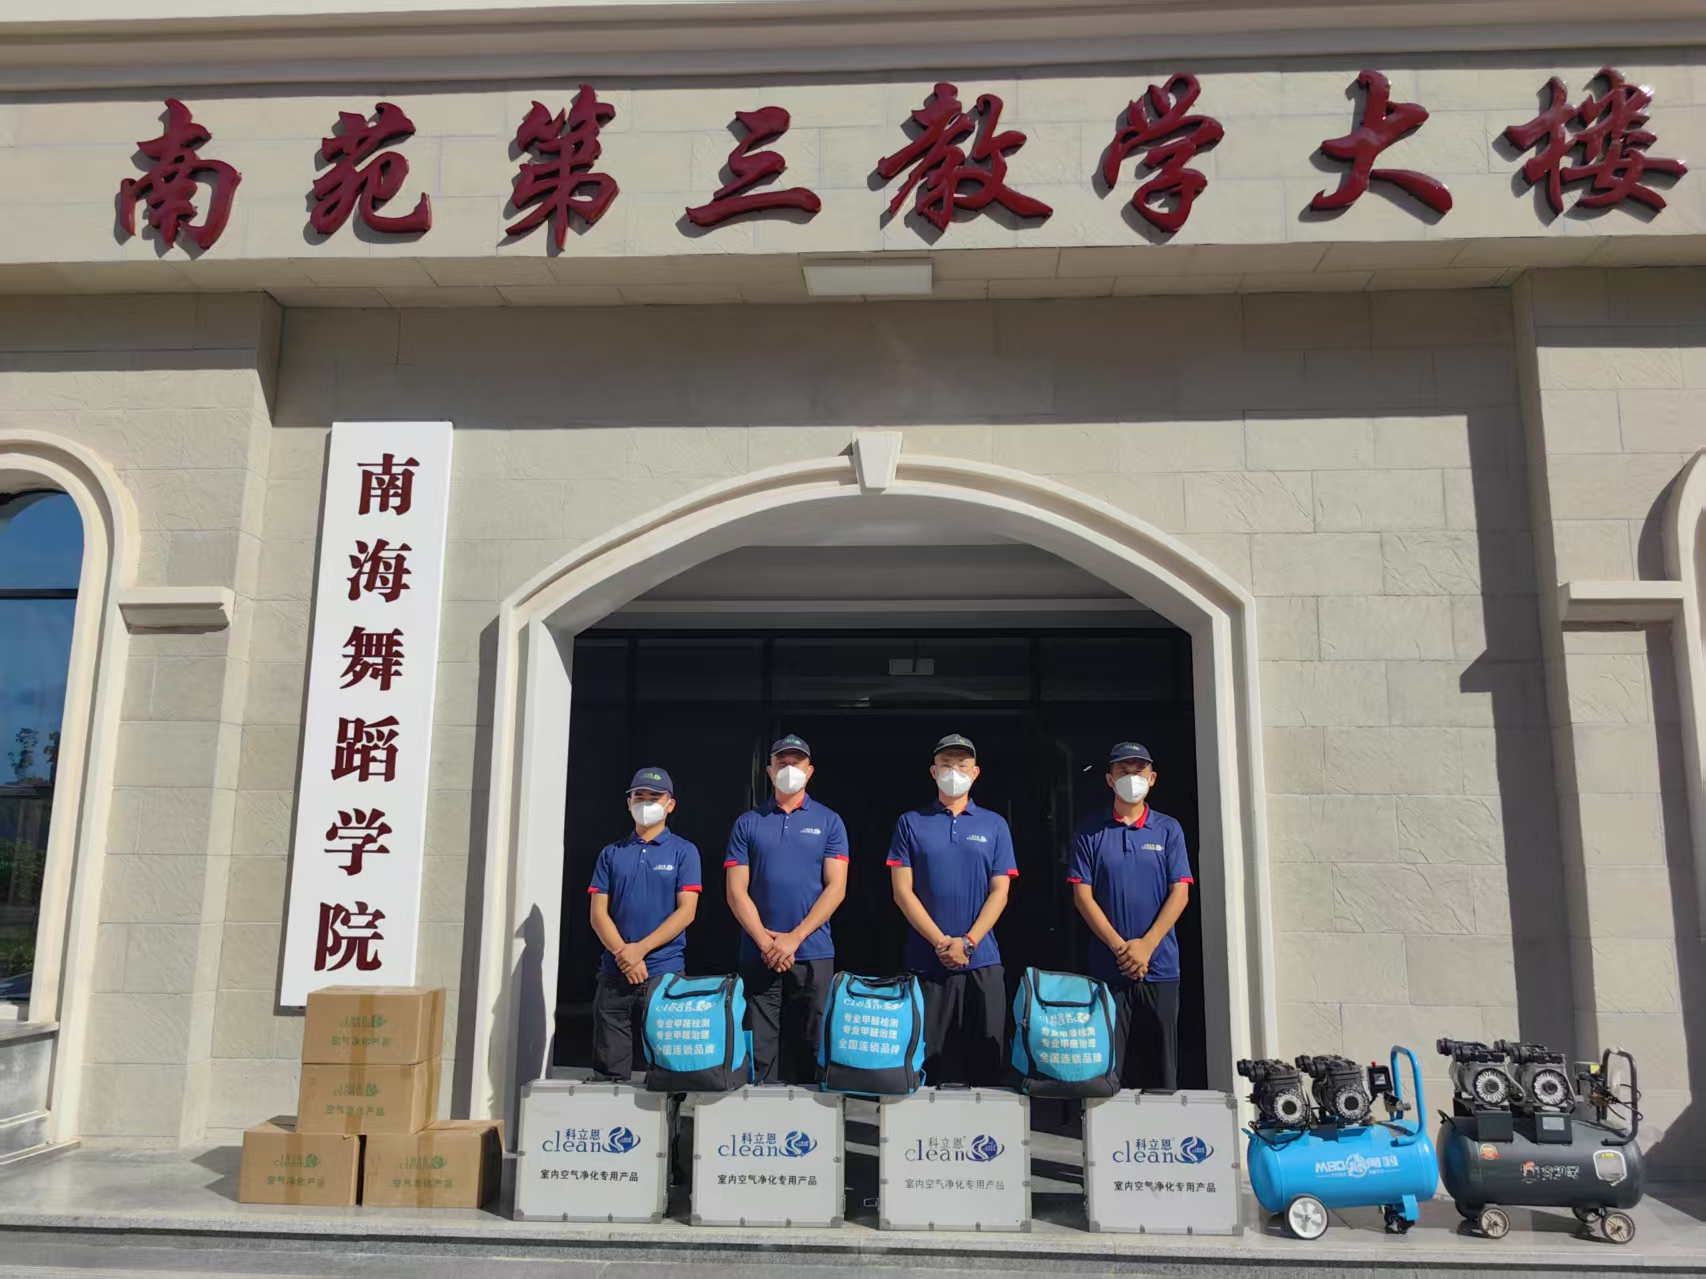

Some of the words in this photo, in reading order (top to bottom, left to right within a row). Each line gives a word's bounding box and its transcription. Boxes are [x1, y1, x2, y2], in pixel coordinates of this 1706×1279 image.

[118, 66, 1689, 252] 南苑第三教学大楼
[313, 452, 420, 973] 南海舞蹈学院
[565, 1127, 601, 1141] 科立恩
[741, 1132, 777, 1145] 科立恩
[541, 1130, 602, 1154] clean
[717, 1134, 779, 1158] clean
[928, 1136, 964, 1149] 科立恩
[1135, 1138, 1173, 1151] 科立恩
[904, 1138, 965, 1162] clean
[1112, 1140, 1173, 1165] clean
[540, 1168, 639, 1182] 室内空气净化专用产品
[717, 1173, 818, 1187] 室内空气净化专用产品
[904, 1177, 1005, 1191] 室内空气净化专用产品
[1113, 1180, 1217, 1193] 室内空气净化专用产品
